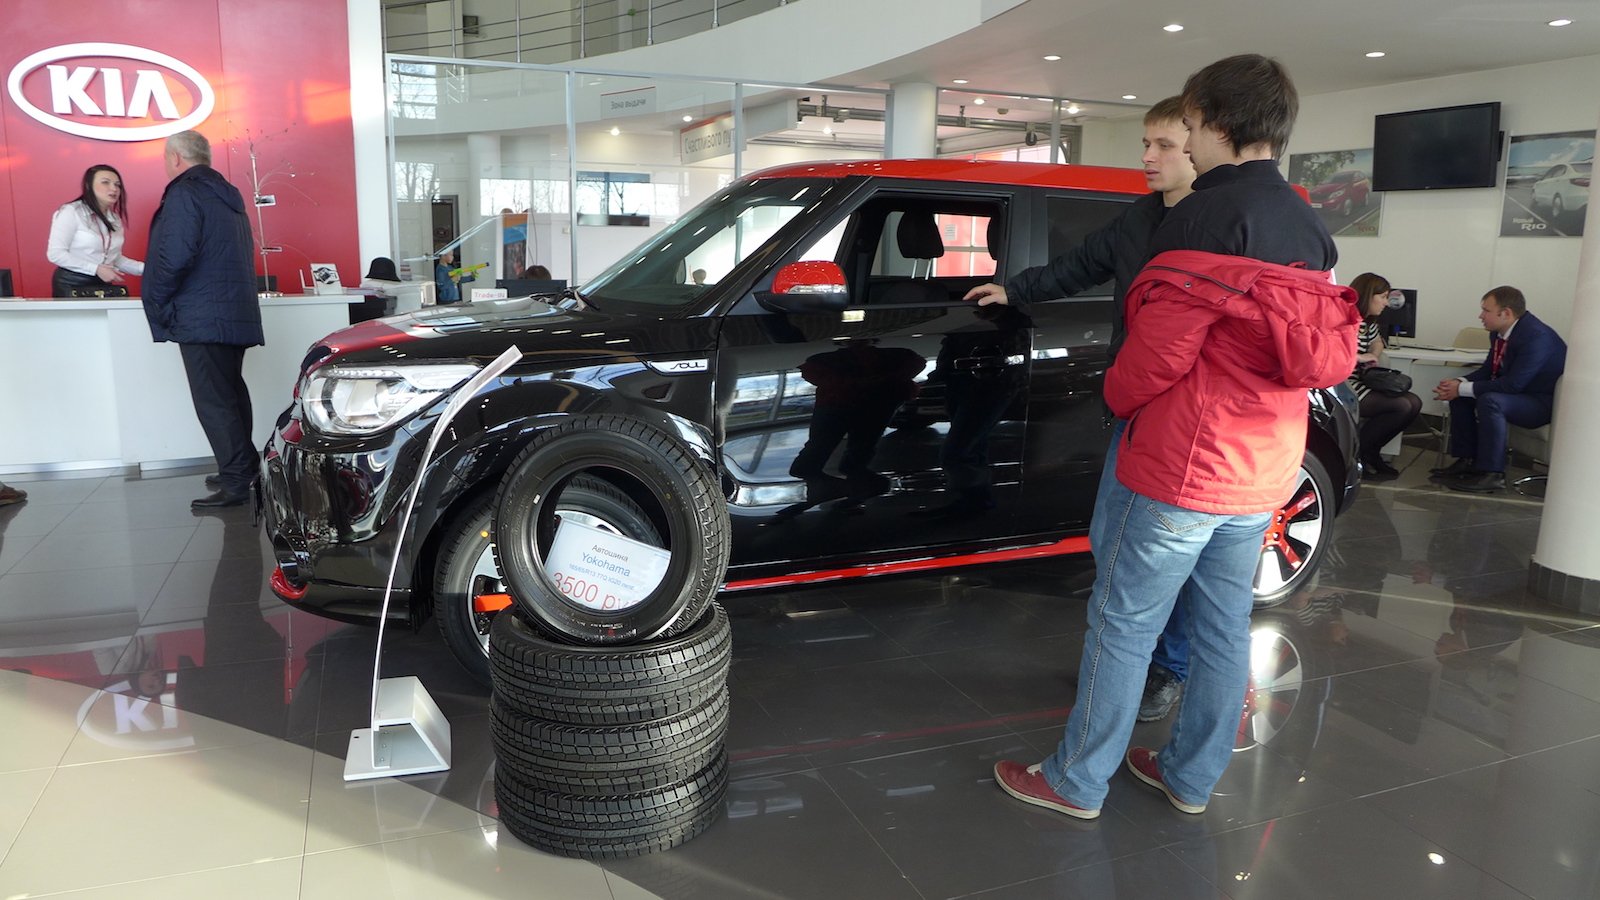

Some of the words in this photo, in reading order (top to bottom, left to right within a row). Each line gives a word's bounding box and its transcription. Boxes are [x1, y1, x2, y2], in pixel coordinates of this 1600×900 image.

[46, 64, 181, 120] KIA
[1521, 223, 1547, 231] RIO
[582, 552, 631, 577] Yokohama
[591, 543, 629, 563] Автошина
[553, 572, 598, 603] 3500
